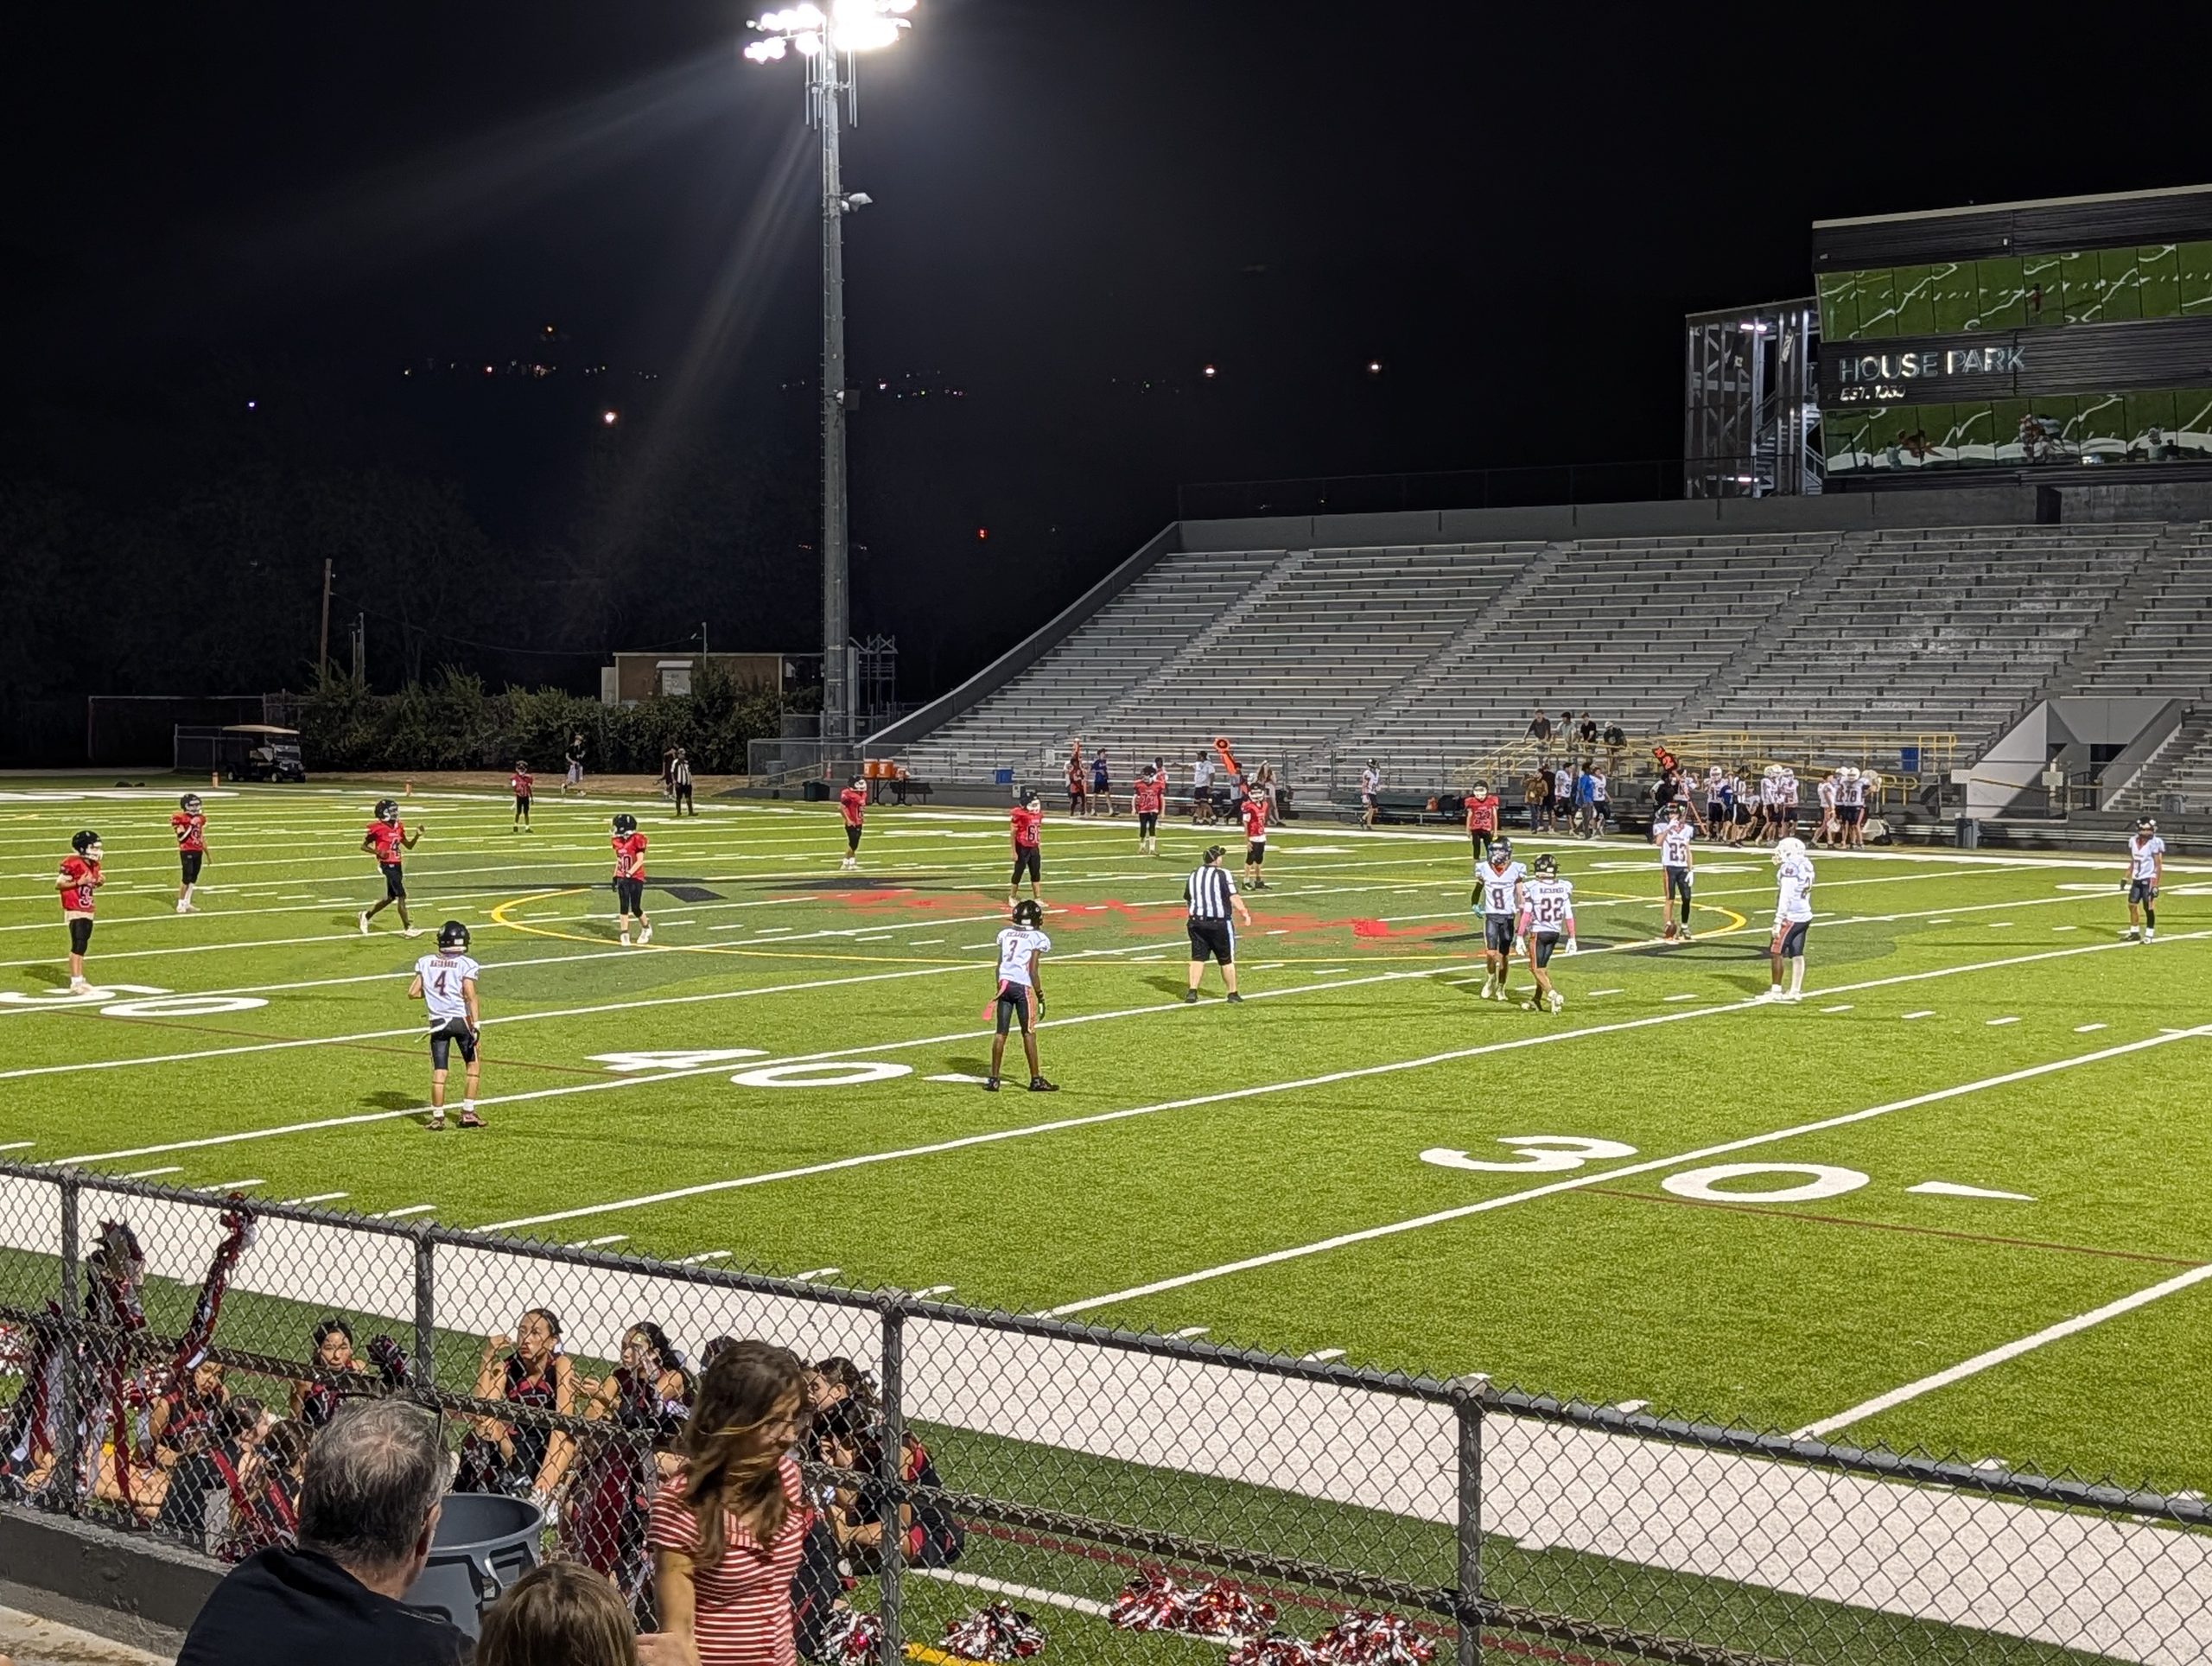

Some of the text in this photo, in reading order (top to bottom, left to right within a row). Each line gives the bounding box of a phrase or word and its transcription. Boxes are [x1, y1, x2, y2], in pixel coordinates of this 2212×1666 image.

[1840, 347, 2026, 383] HOUSE PARK
[1839, 385, 1871, 401] EST.
[1669, 843, 1687, 862] 23
[1491, 887, 1505, 910] 8
[1541, 897, 1565, 922] 22
[1003, 939, 1018, 962] 3
[434, 970, 448, 996] 4
[583, 1048, 914, 1088] 40
[1418, 1135, 1871, 1203] 30
